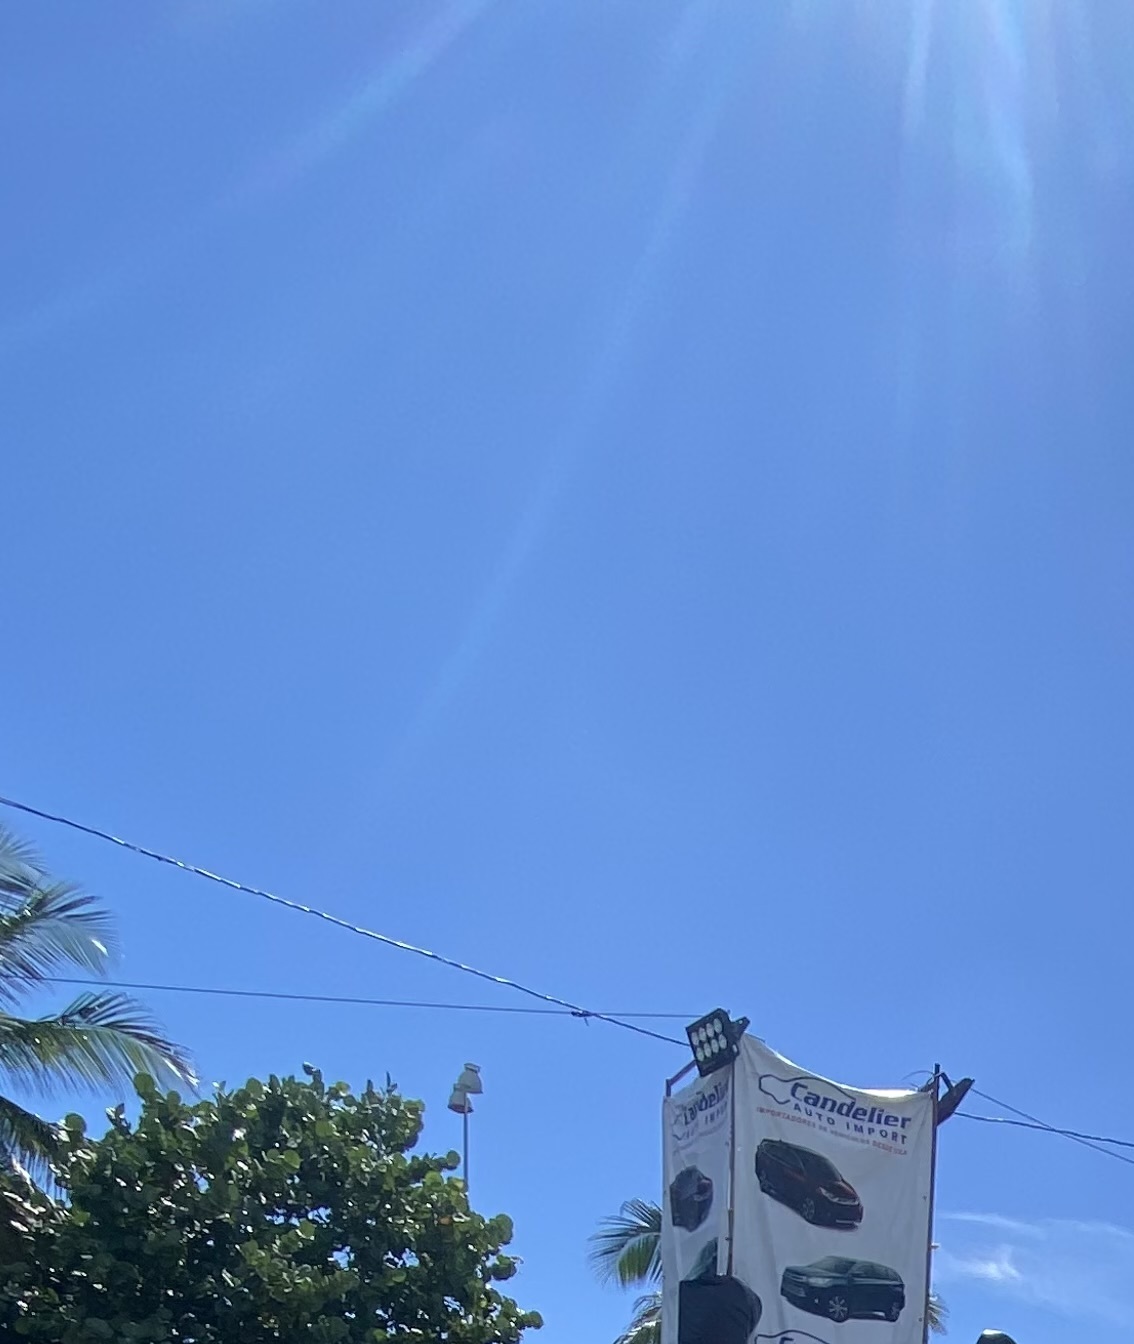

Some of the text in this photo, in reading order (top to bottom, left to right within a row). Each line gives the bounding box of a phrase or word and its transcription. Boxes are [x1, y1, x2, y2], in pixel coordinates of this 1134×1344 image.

[791, 1082, 912, 1129] Candelier
[793, 1102, 907, 1146] AUTO IMPORT
